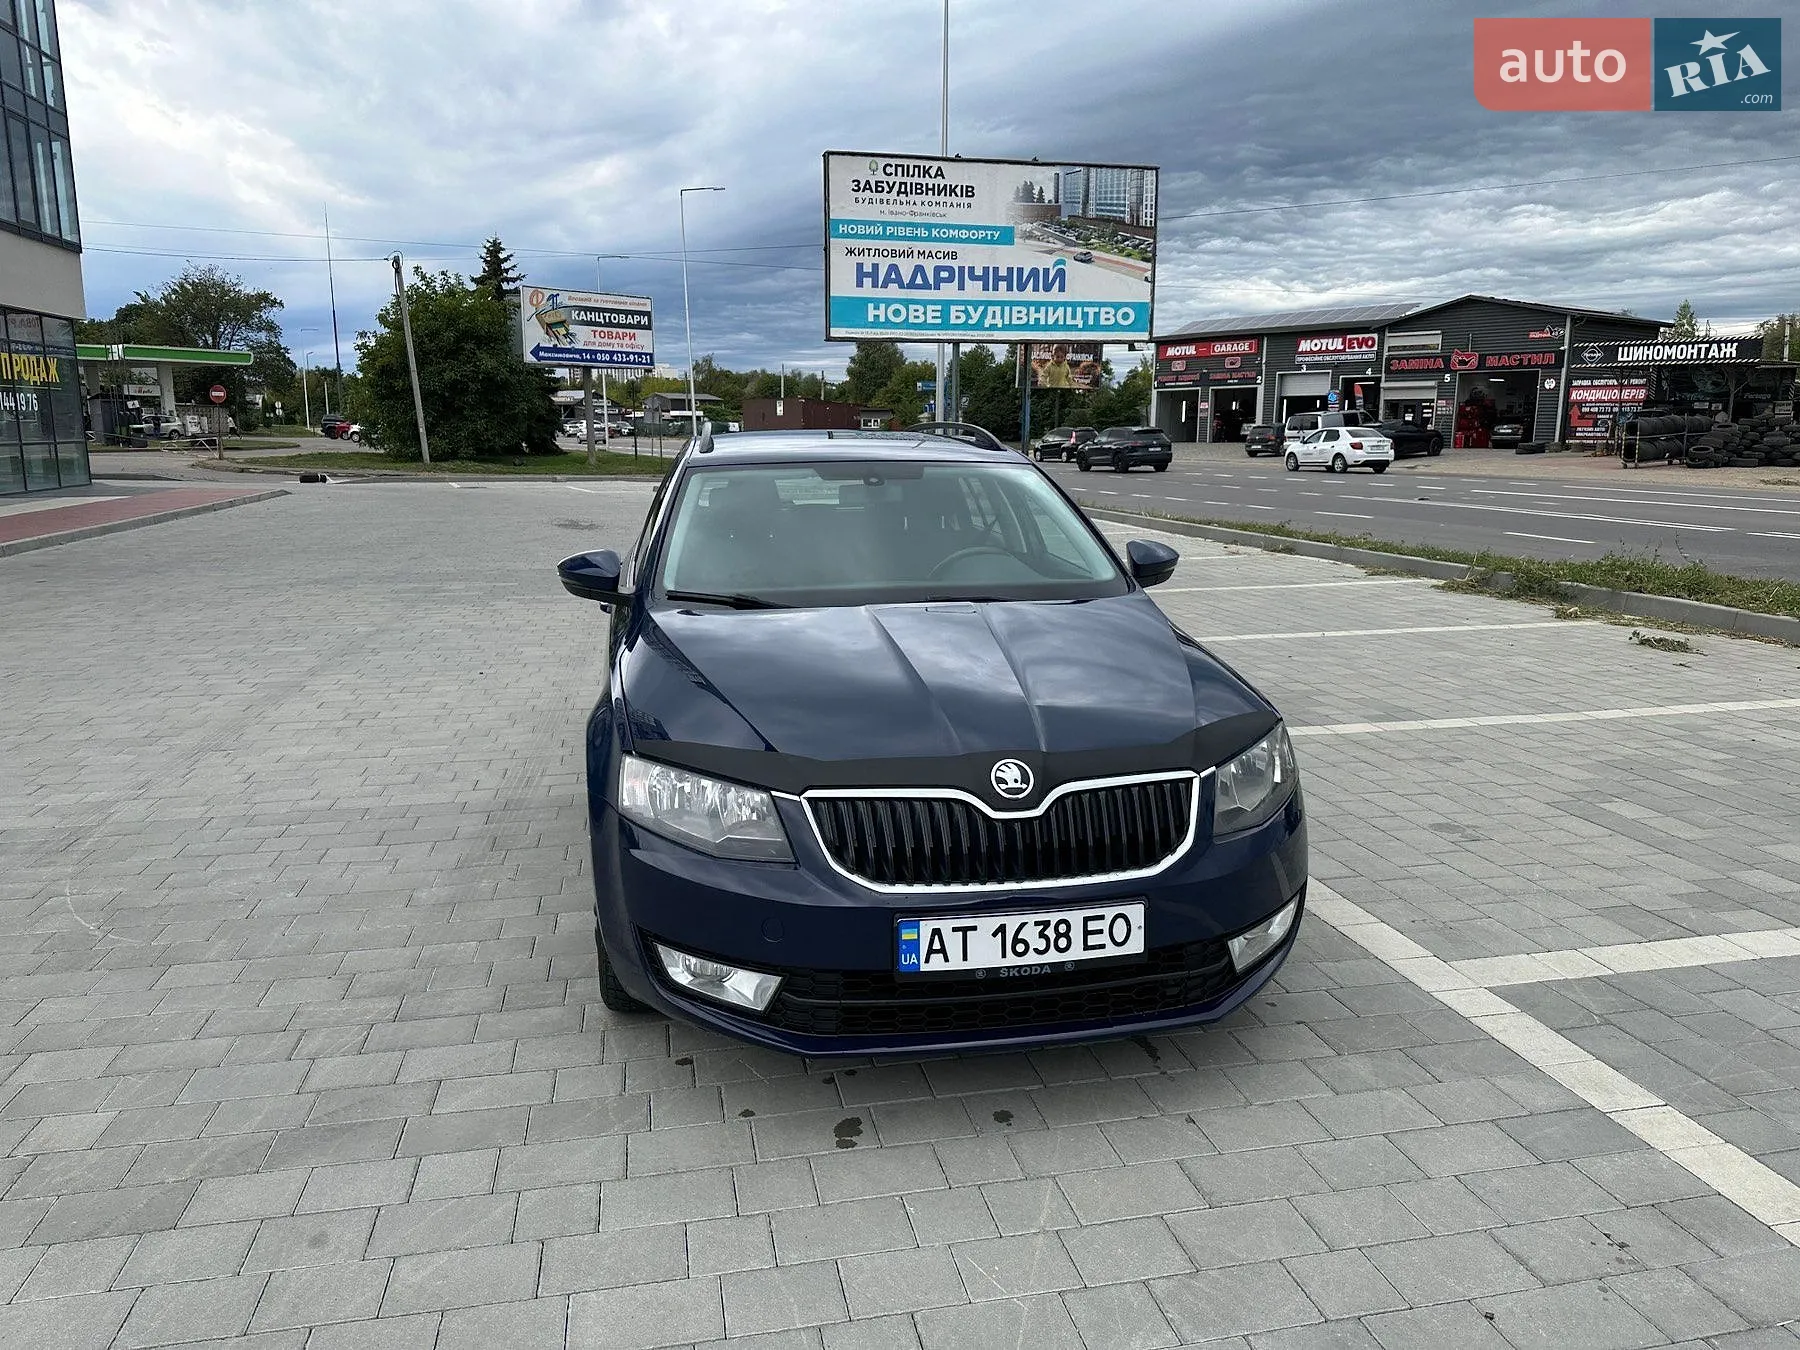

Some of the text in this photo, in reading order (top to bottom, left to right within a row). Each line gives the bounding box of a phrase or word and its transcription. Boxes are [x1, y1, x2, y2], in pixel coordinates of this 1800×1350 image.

[882, 162, 946, 180] СПІЛКА
[851, 179, 976, 199] ЗАБУДІВНИКІВ
[854, 197, 973, 210] БУДІВЕЛЬНА КОМПАНІЯ
[838, 222, 1001, 242] НОВИЙ РІВЕНЬ КОМФОРТУ
[844, 245, 958, 261] ЖИТЛОВИЙ МАСИВ
[855, 258, 1068, 293] НАДРІЧНИЙ
[571, 310, 649, 326] КАНЦТОВАРИ
[866, 302, 1136, 330] НОВЕ БУДІВНИЦТВО
[591, 329, 636, 341] ТОВАРИ
[583, 340, 598, 348] для
[598, 342, 615, 350] дому
[625, 342, 645, 351] офісу
[1166, 345, 1197, 357] MOTUL
[1214, 342, 1250, 353] GARAGE
[1298, 336, 1376, 352] MOTUL EVO
[1617, 343, 1737, 361] ШИНОМОНТАЖ
[582, 352, 591, 360] 14
[596, 353, 610, 362] 050
[1390, 353, 1555, 371] ЗАМІНА МАСТИЛ
[0, 353, 60, 385] ПРОДАЖ
[1301, 364, 1307, 372] 3
[1365, 368, 1372, 376] 4
[1256, 376, 1262, 384] 2
[1444, 374, 1451, 383] 5
[27, 394, 39, 411] 76
[901, 912, 1132, 965] UA AT 1638 EO
